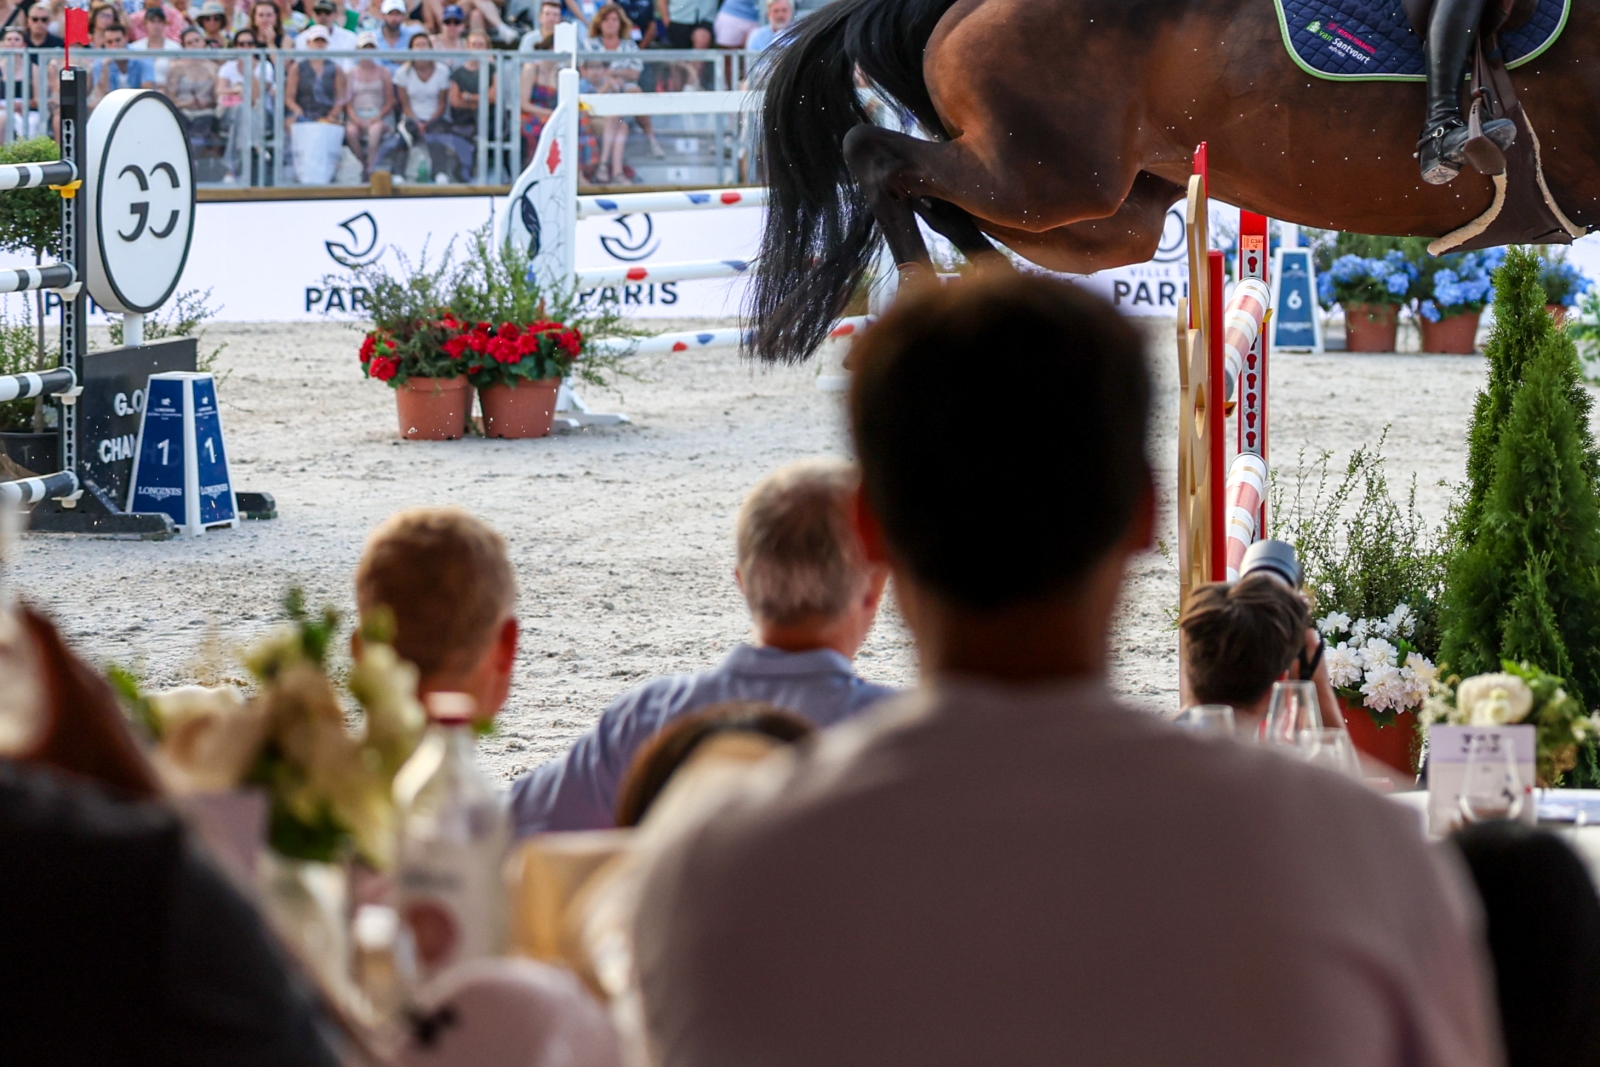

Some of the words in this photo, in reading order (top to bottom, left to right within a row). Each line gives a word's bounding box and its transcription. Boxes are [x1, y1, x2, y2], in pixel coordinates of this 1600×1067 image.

[1319, 30, 1333, 42] van
[1332, 37, 1371, 65] Santvoort
[305, 286, 368, 313] PAR
[1113, 280, 1188, 306] PARI
[1287, 289, 1302, 310] 6
[157, 438, 170, 466] 1
[204, 437, 217, 464] 1
